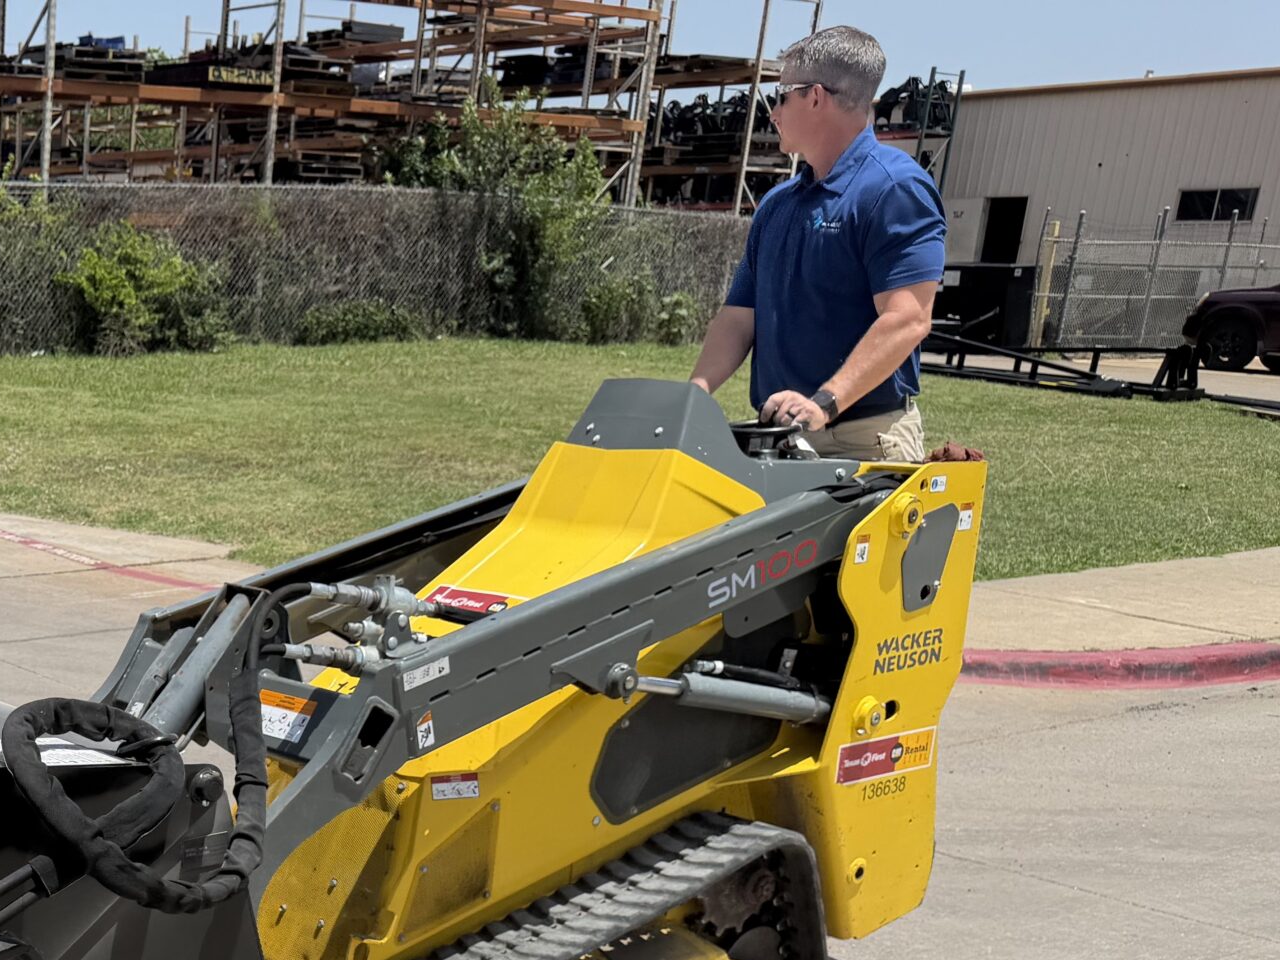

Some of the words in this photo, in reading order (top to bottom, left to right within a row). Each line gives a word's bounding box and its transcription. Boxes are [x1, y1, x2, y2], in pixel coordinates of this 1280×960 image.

[707, 538, 818, 609] SM100
[877, 627, 943, 657] WACKER
[873, 646, 942, 676] NEUSON
[905, 742, 929, 756] Rental
[861, 775, 906, 801] 136638
